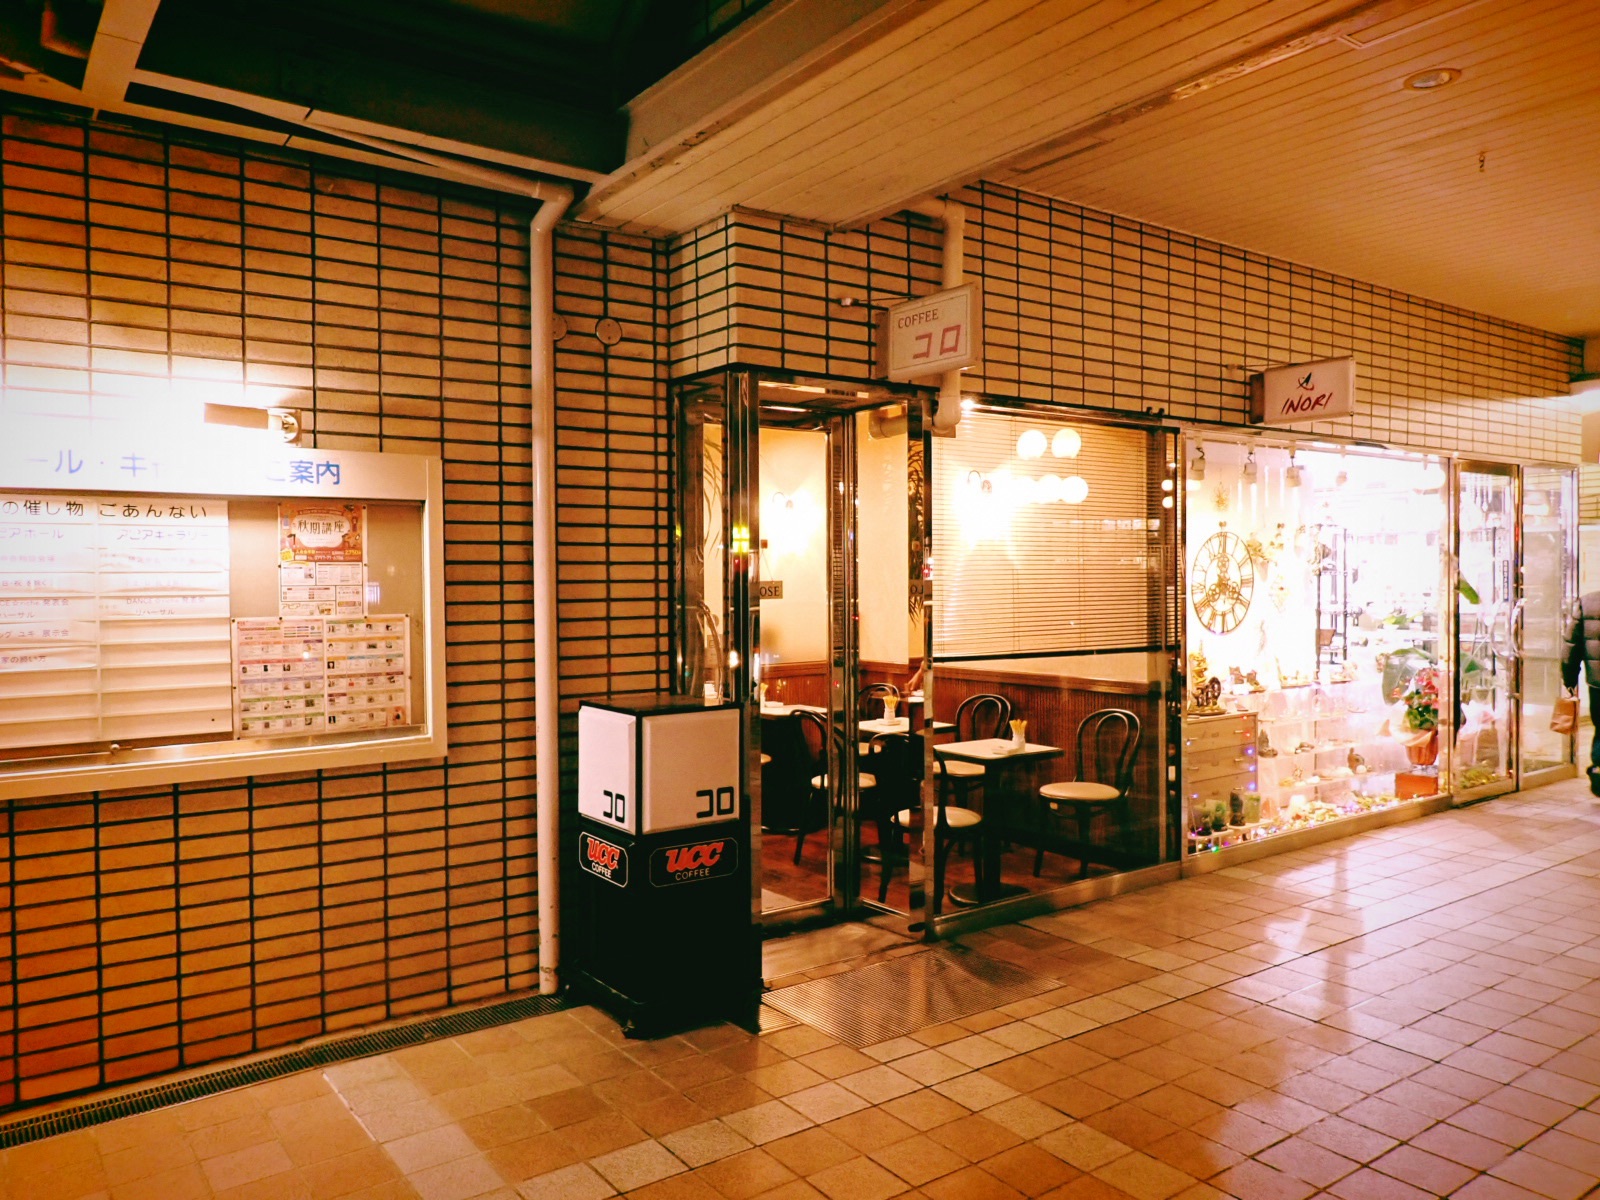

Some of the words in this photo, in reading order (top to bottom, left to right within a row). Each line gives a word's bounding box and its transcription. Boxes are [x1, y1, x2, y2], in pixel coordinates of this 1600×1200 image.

[898, 309, 939, 329] COFFEE
[912, 324, 962, 360] コロ
[1281, 392, 1333, 415] INORI
[2, 499, 84, 517] の催し物
[298, 519, 345, 535] 秋期講座
[603, 789, 626, 824] コロ
[696, 786, 735, 819] コロ
[587, 837, 620, 870] UCC
[665, 841, 725, 873] UCC
[591, 862, 612, 879] COFFEE
[675, 867, 711, 882] COFFEE
